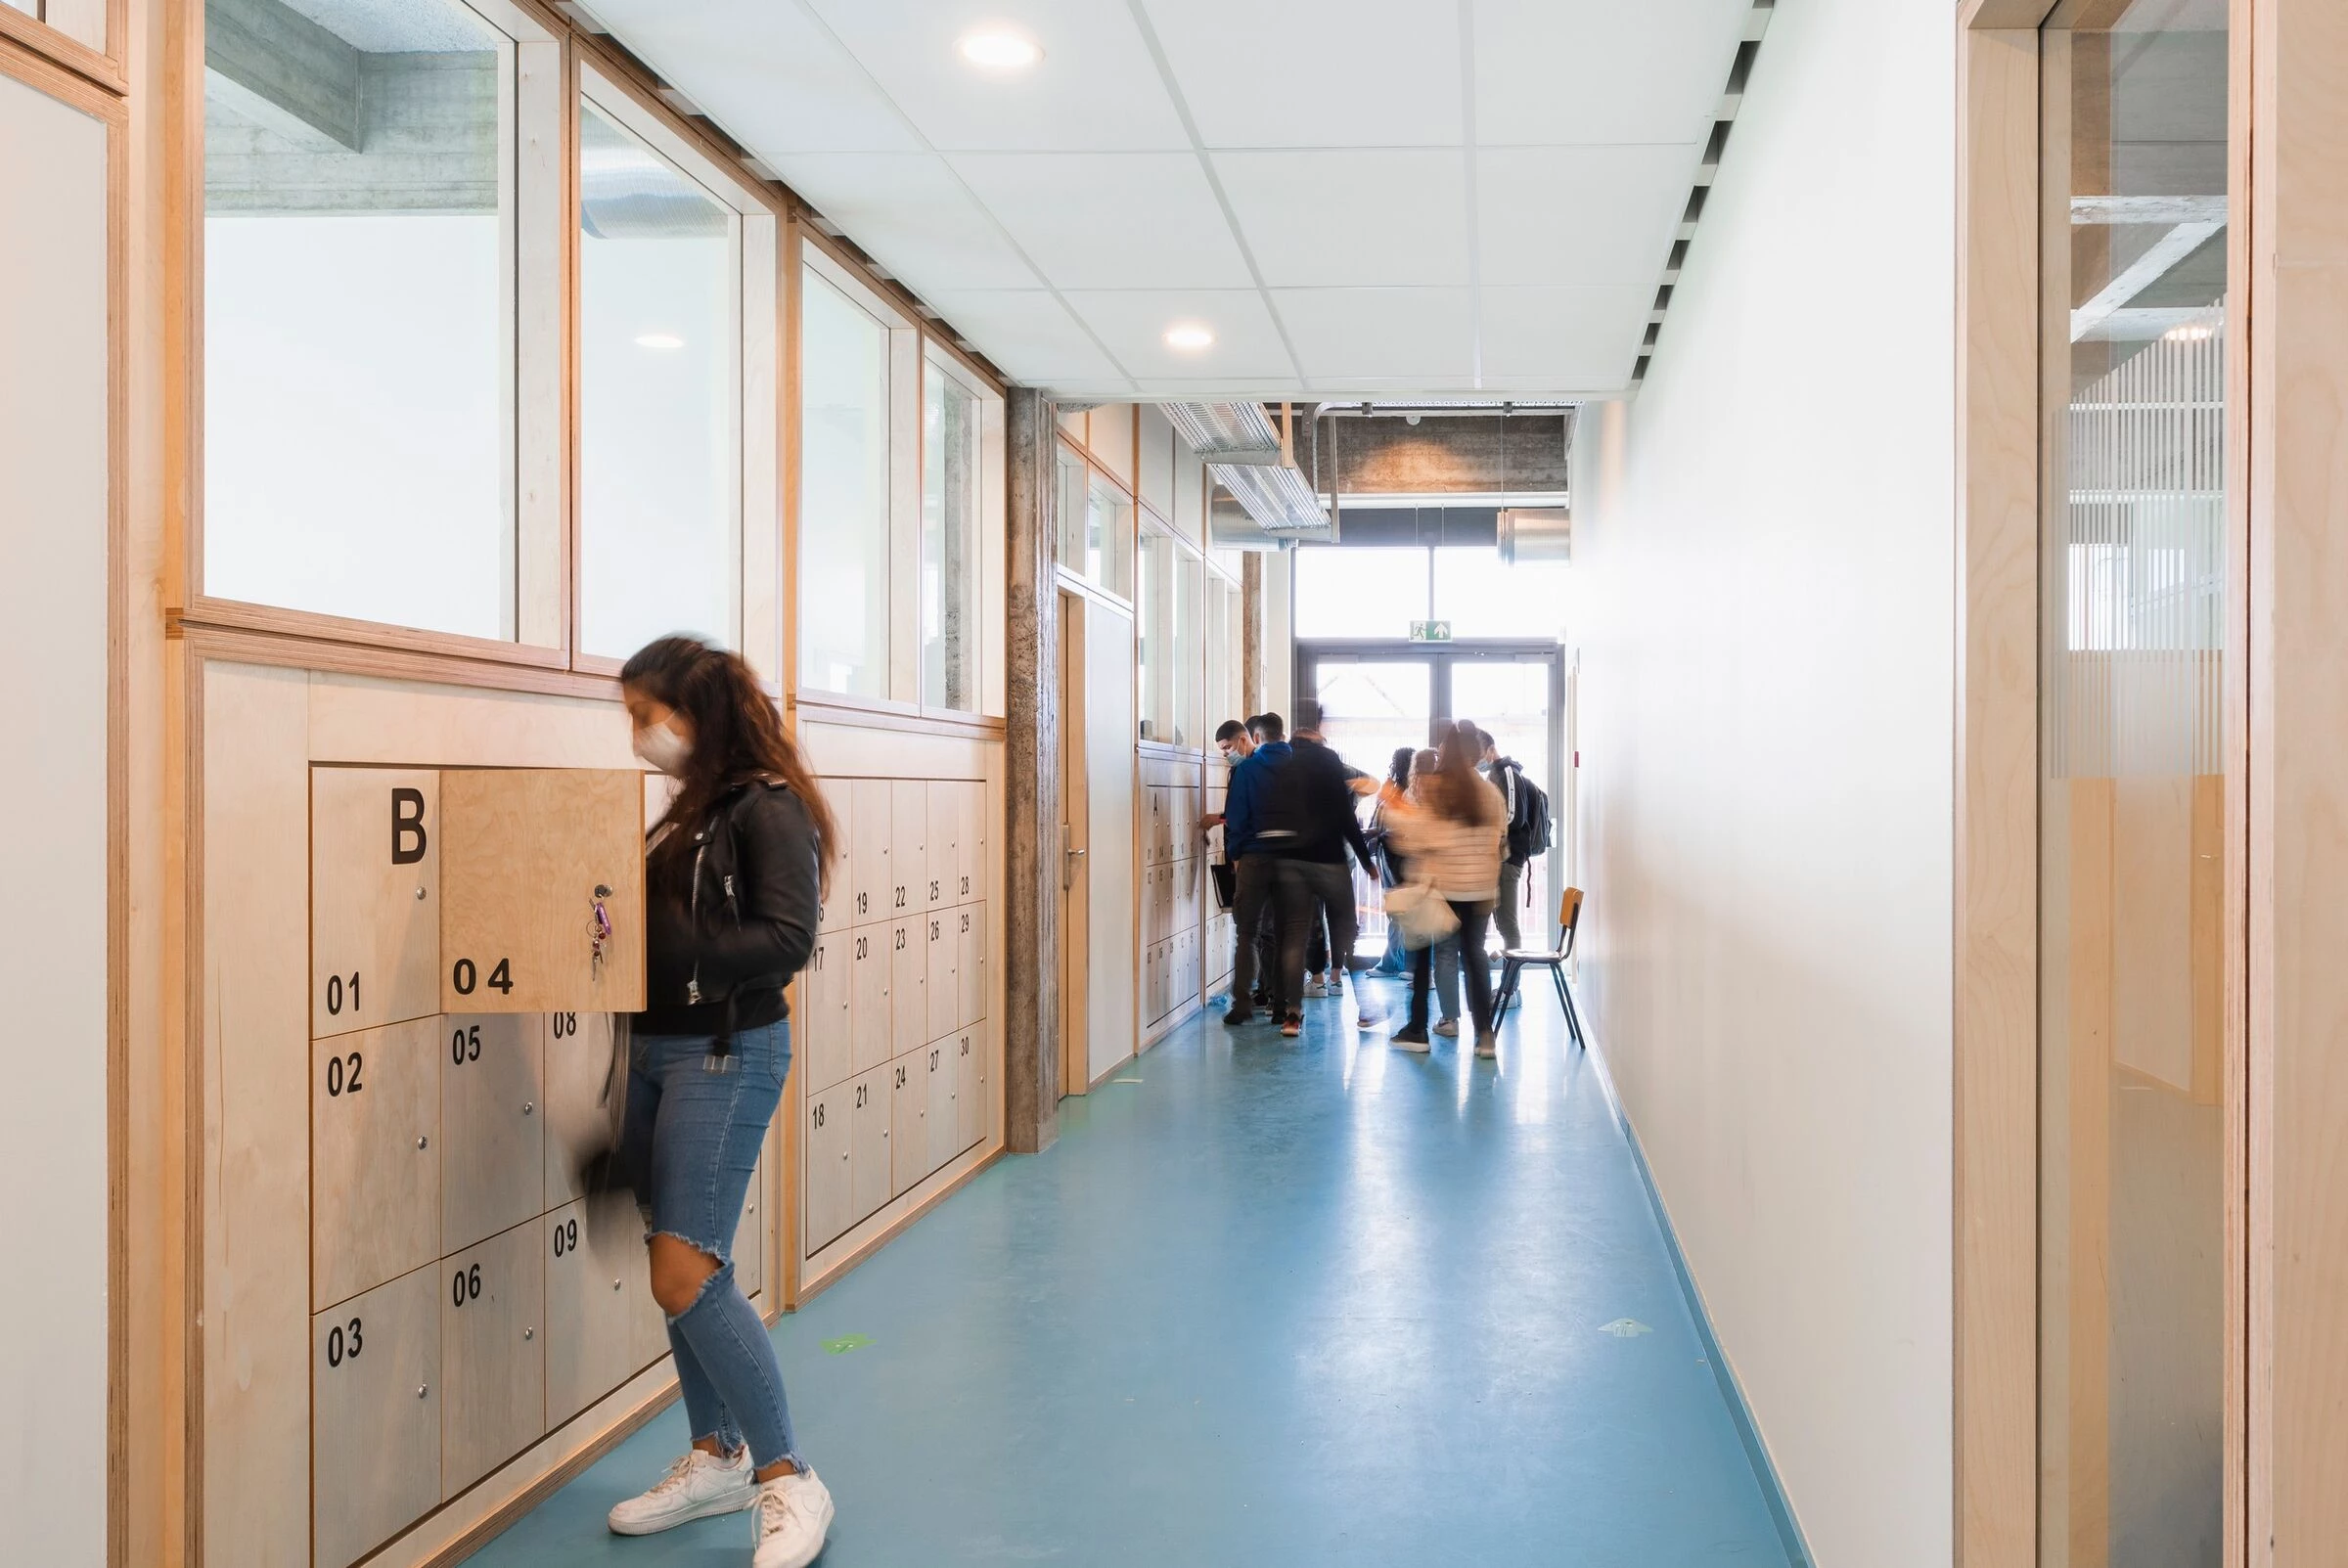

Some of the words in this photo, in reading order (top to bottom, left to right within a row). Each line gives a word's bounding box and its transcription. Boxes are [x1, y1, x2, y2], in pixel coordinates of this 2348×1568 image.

[1152, 792, 1158, 817] A
[392, 788, 427, 865] B
[895, 886, 905, 908] 22
[929, 881, 938, 901] 25
[961, 876, 969, 895] 28
[856, 892, 867, 915] 19
[930, 920, 939, 941] 26
[961, 914, 969, 932] 29
[856, 937, 867, 960] 20
[895, 928, 905, 950] 23
[812, 946, 825, 972] 17
[454, 959, 513, 995] 04
[328, 972, 359, 1015] 01
[554, 1012, 576, 1039] 08
[453, 1025, 480, 1065] 05
[961, 1037, 969, 1056] 30
[929, 1050, 938, 1072] 27
[328, 1053, 362, 1097] 02
[895, 1066, 905, 1089] 24
[856, 1084, 867, 1108] 21
[812, 1103, 824, 1129] 18
[555, 1220, 576, 1257] 09
[453, 1263, 480, 1307] 06
[327, 1318, 362, 1367] 03
